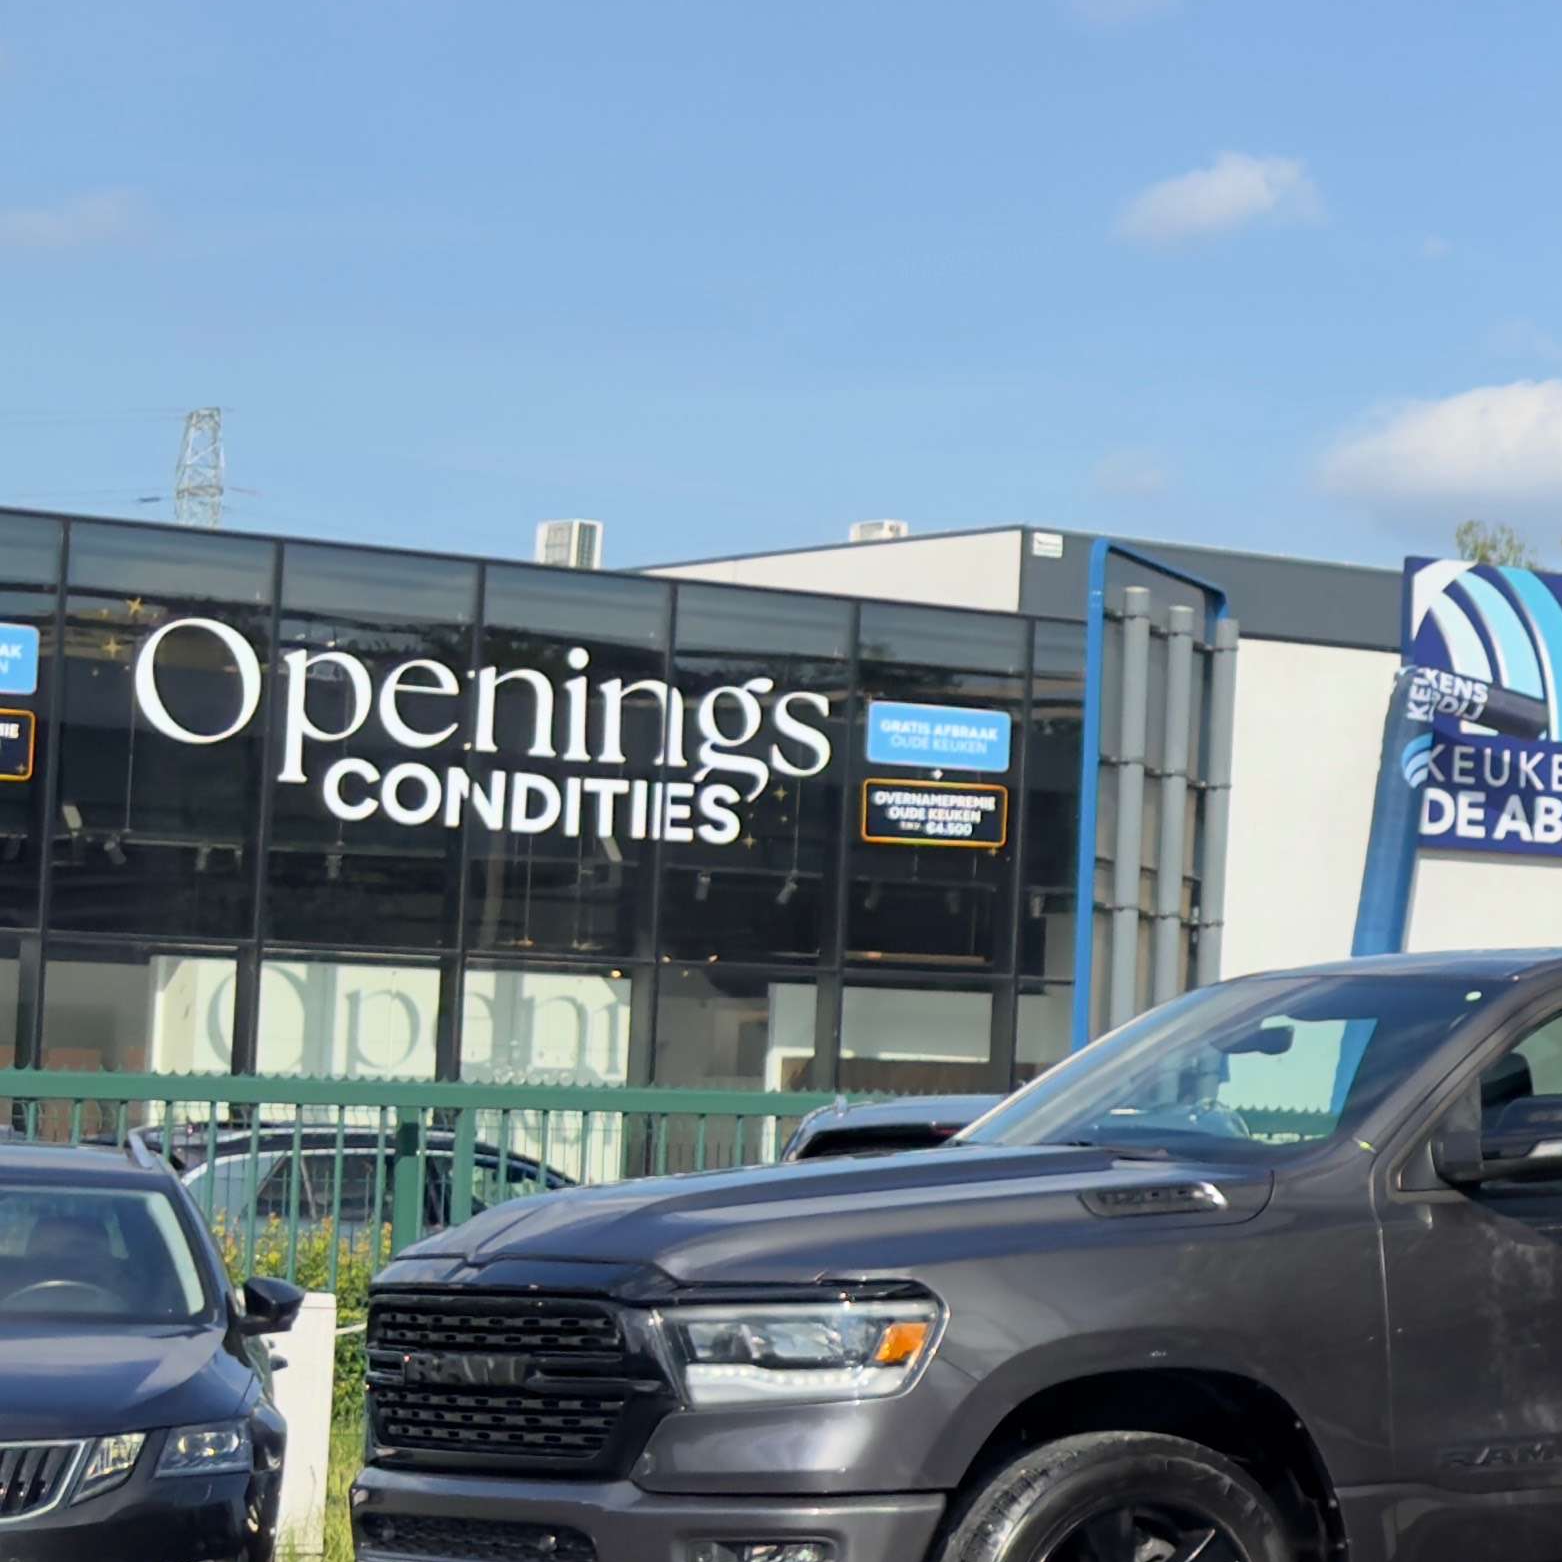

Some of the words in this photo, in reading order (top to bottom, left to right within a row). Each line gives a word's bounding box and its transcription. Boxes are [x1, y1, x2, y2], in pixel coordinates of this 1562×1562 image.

[134, 615, 833, 803] Openings
[880, 719, 931, 736] GRATIS
[890, 735, 930, 750] OUDE
[932, 737, 989, 754] KEUKEN
[321, 759, 741, 846] CONDITIES
[887, 805, 926, 821] OUDE
[927, 808, 982, 824] KEUKEN
[1418, 787, 1487, 839] DE
[1435, 1440, 1557, 1469] RAM
